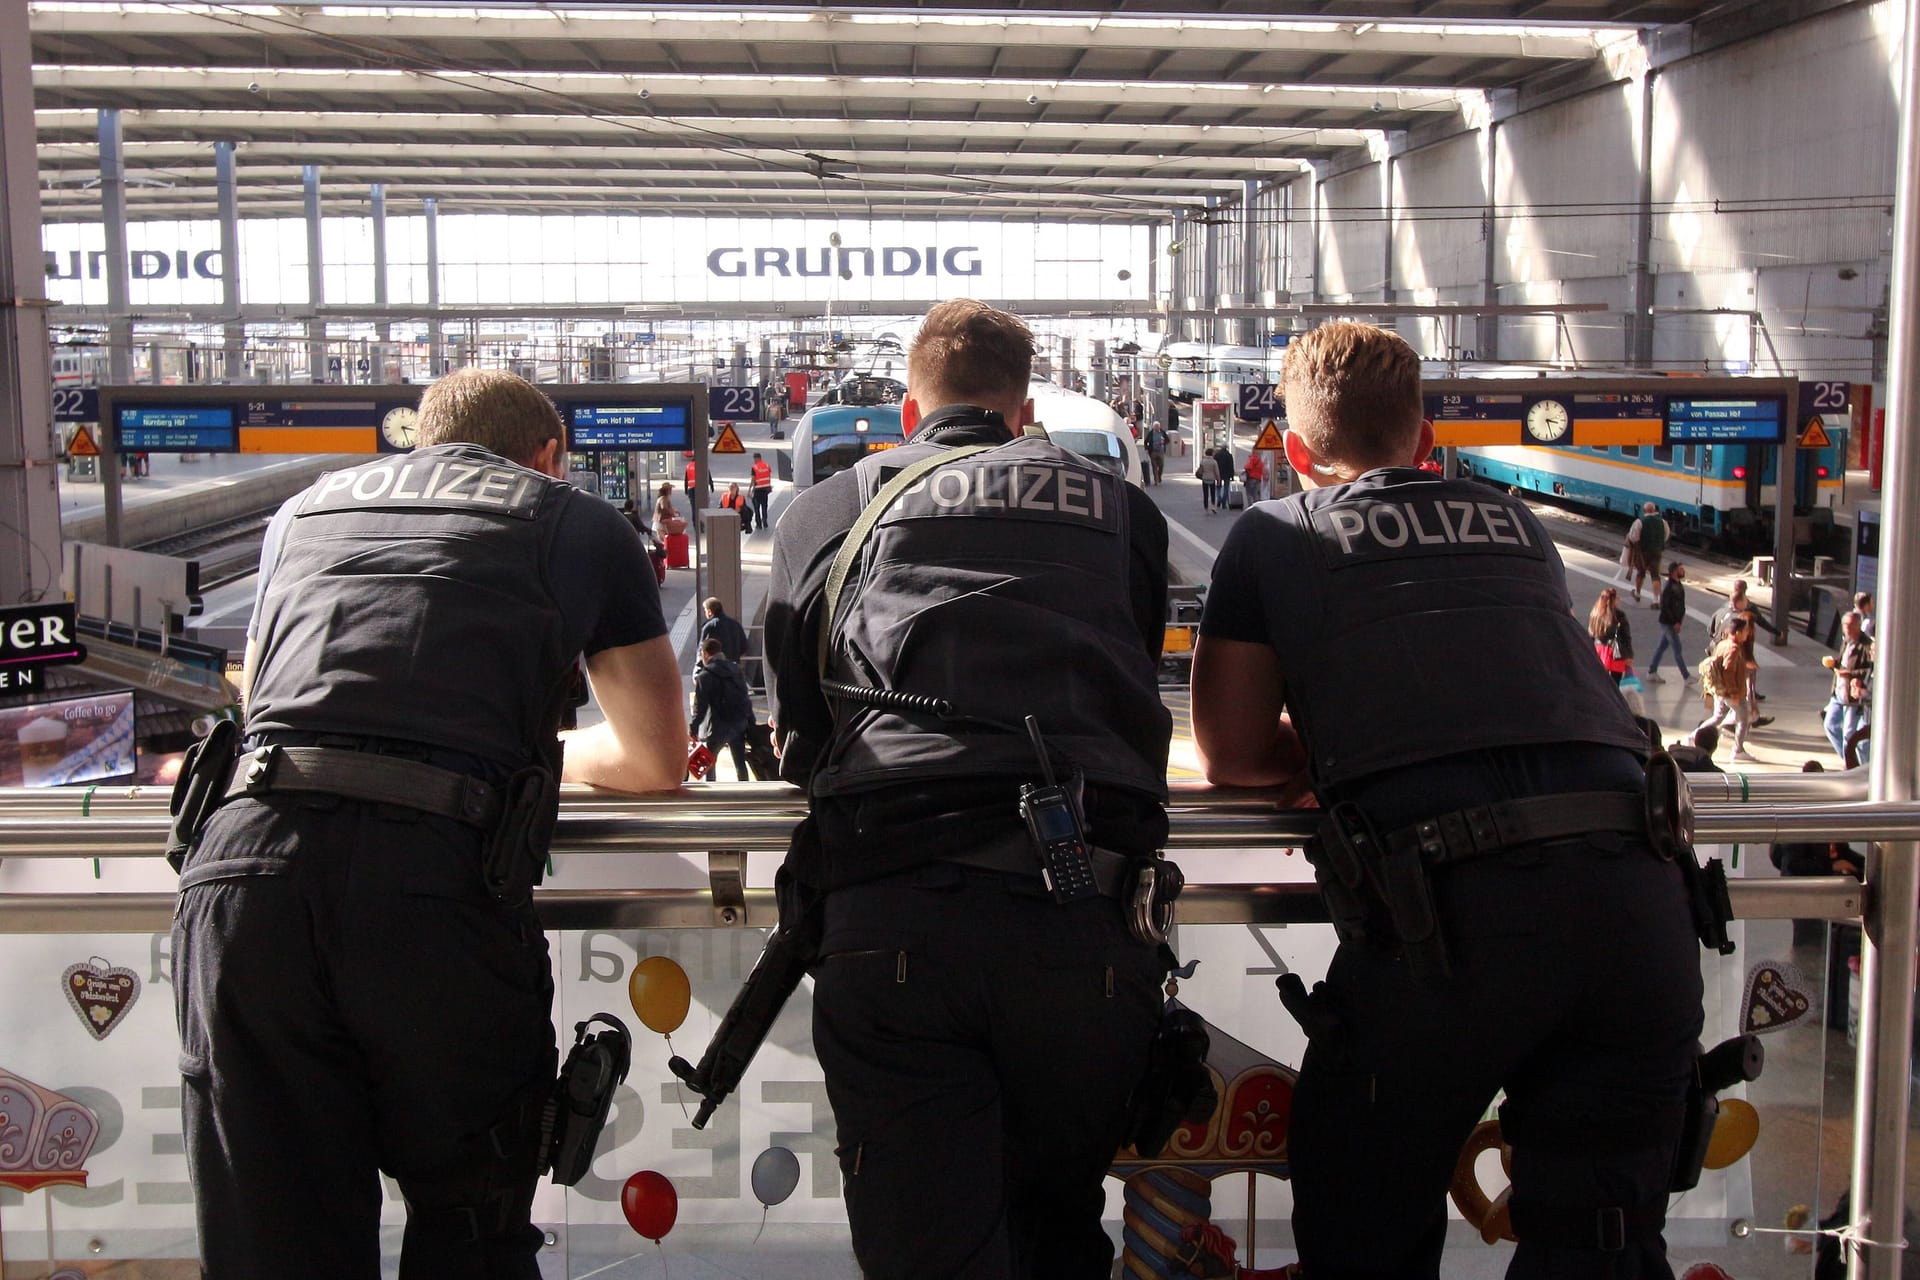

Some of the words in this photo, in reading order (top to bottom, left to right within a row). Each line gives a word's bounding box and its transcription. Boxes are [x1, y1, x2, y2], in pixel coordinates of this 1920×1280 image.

[707, 246, 982, 277] GRUNDIG
[331, 359, 339, 369] A
[360, 359, 368, 369] A
[744, 358, 752, 366] A
[1465, 351, 1473, 360] A
[53, 390, 84, 415] 22
[723, 388, 756, 413] 23
[1244, 385, 1276, 410] 24
[1443, 395, 1461, 404] 5-23
[1813, 382, 1845, 408] 25
[610, 416, 622, 424] Hof
[624, 416, 635, 424] Hbf
[313, 462, 530, 507] POLIZEI
[1328, 500, 1532, 555] POLIZEI
[64, 707, 92, 721] Coffee
[94, 705, 104, 716] to
[105, 704, 117, 717] go
